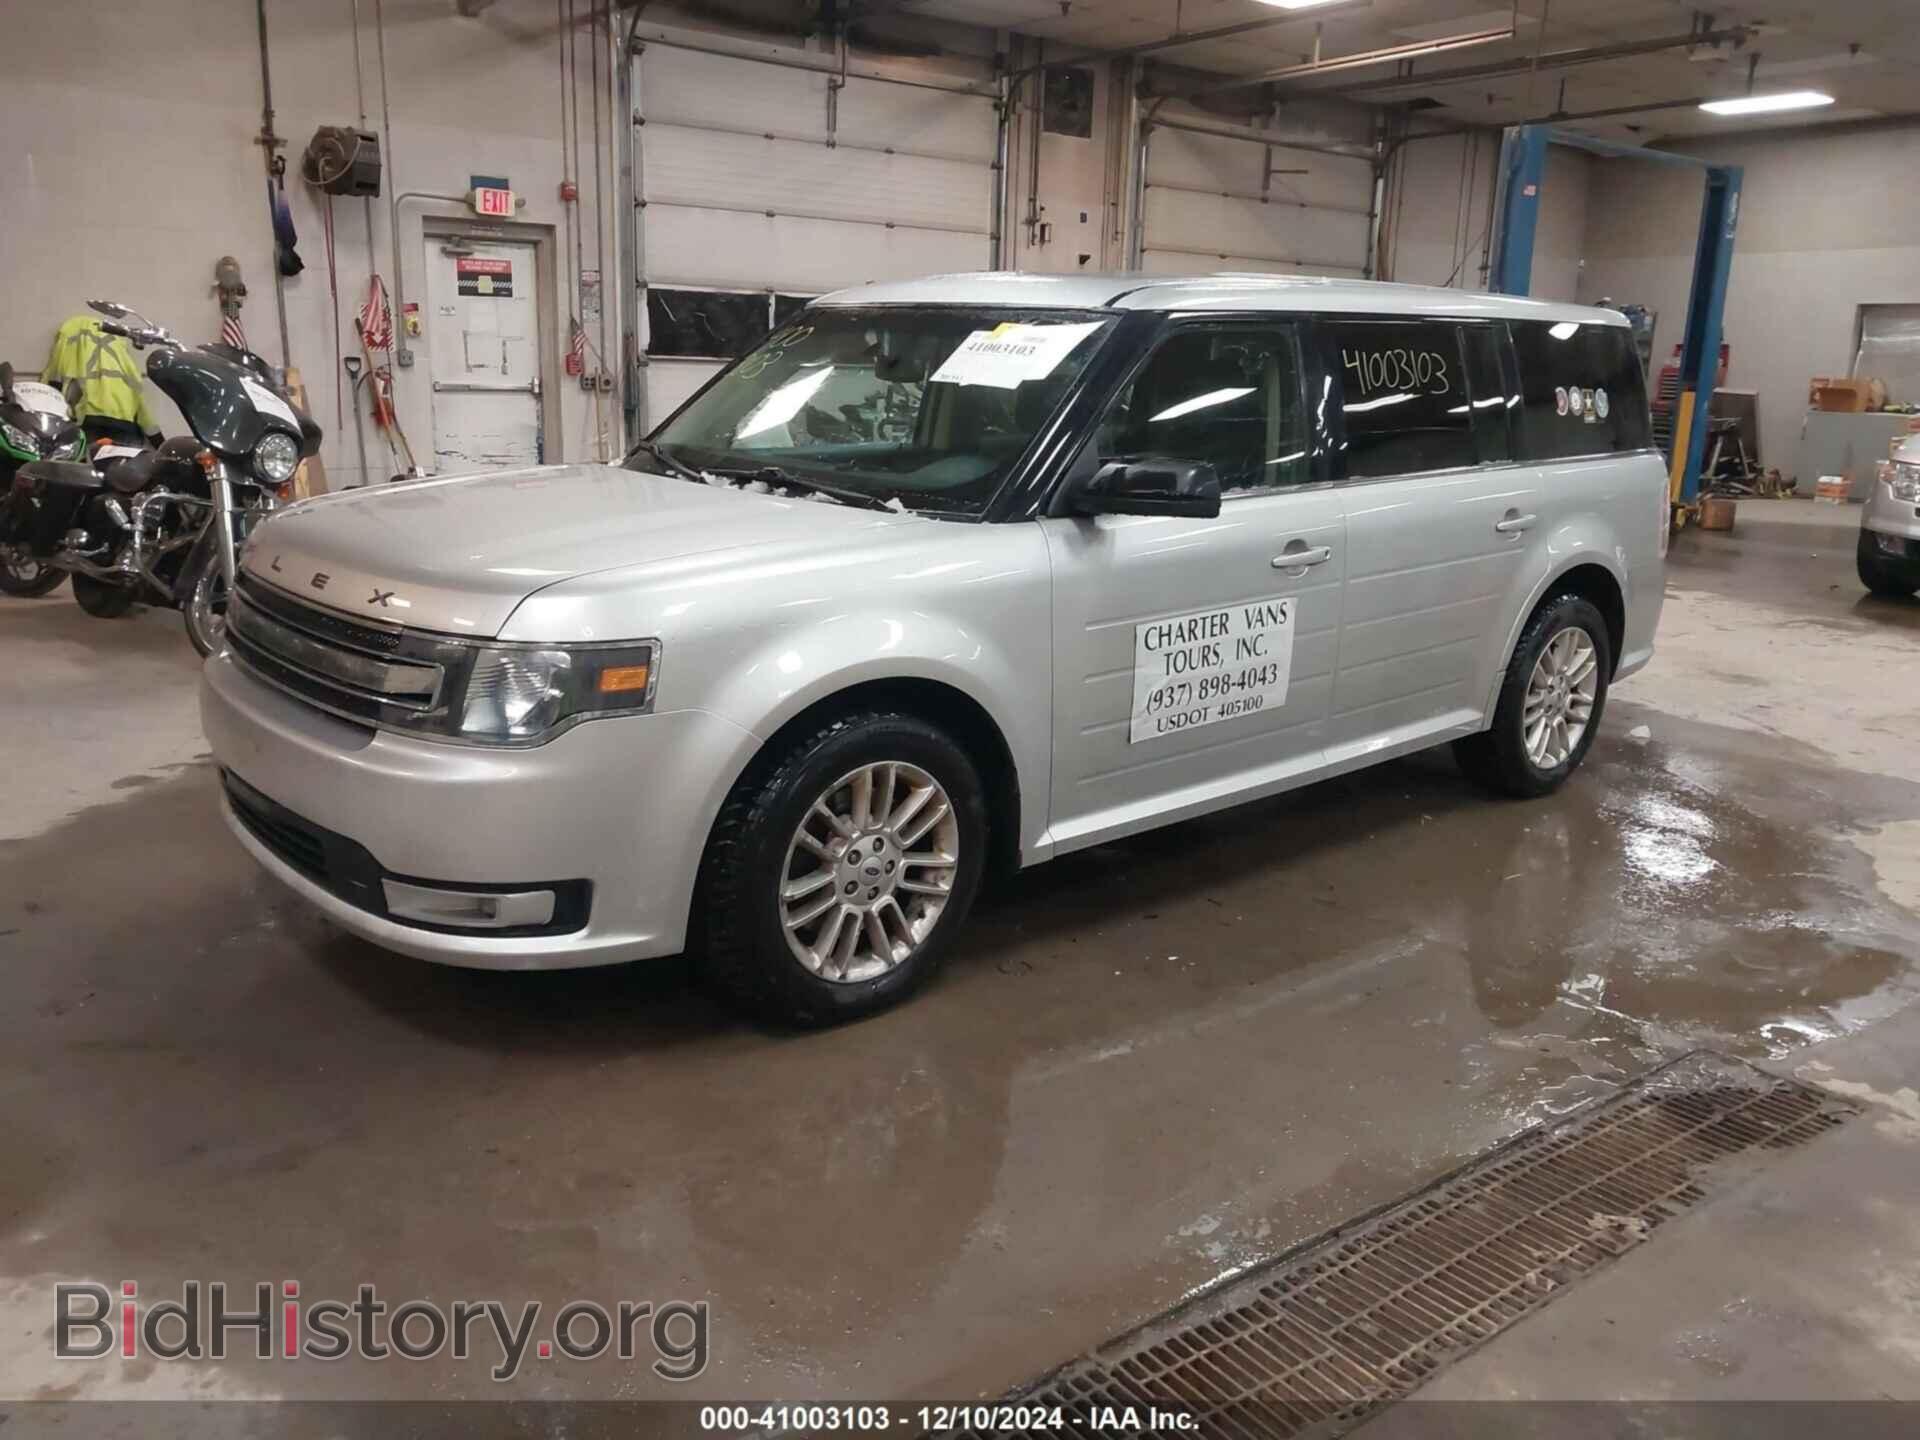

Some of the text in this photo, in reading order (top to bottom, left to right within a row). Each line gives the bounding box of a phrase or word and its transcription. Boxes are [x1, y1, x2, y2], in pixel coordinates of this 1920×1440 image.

[482, 189, 511, 213] EXIT
[967, 342, 1036, 356] 41003103
[1342, 350, 1449, 395] 41003103
[1144, 602, 1288, 651] CHARTER VANS
[1164, 634, 1268, 676] TOURS, INC.
[1146, 663, 1278, 715] (937) 898-4043
[1156, 695, 1264, 733] USDOT 405100
